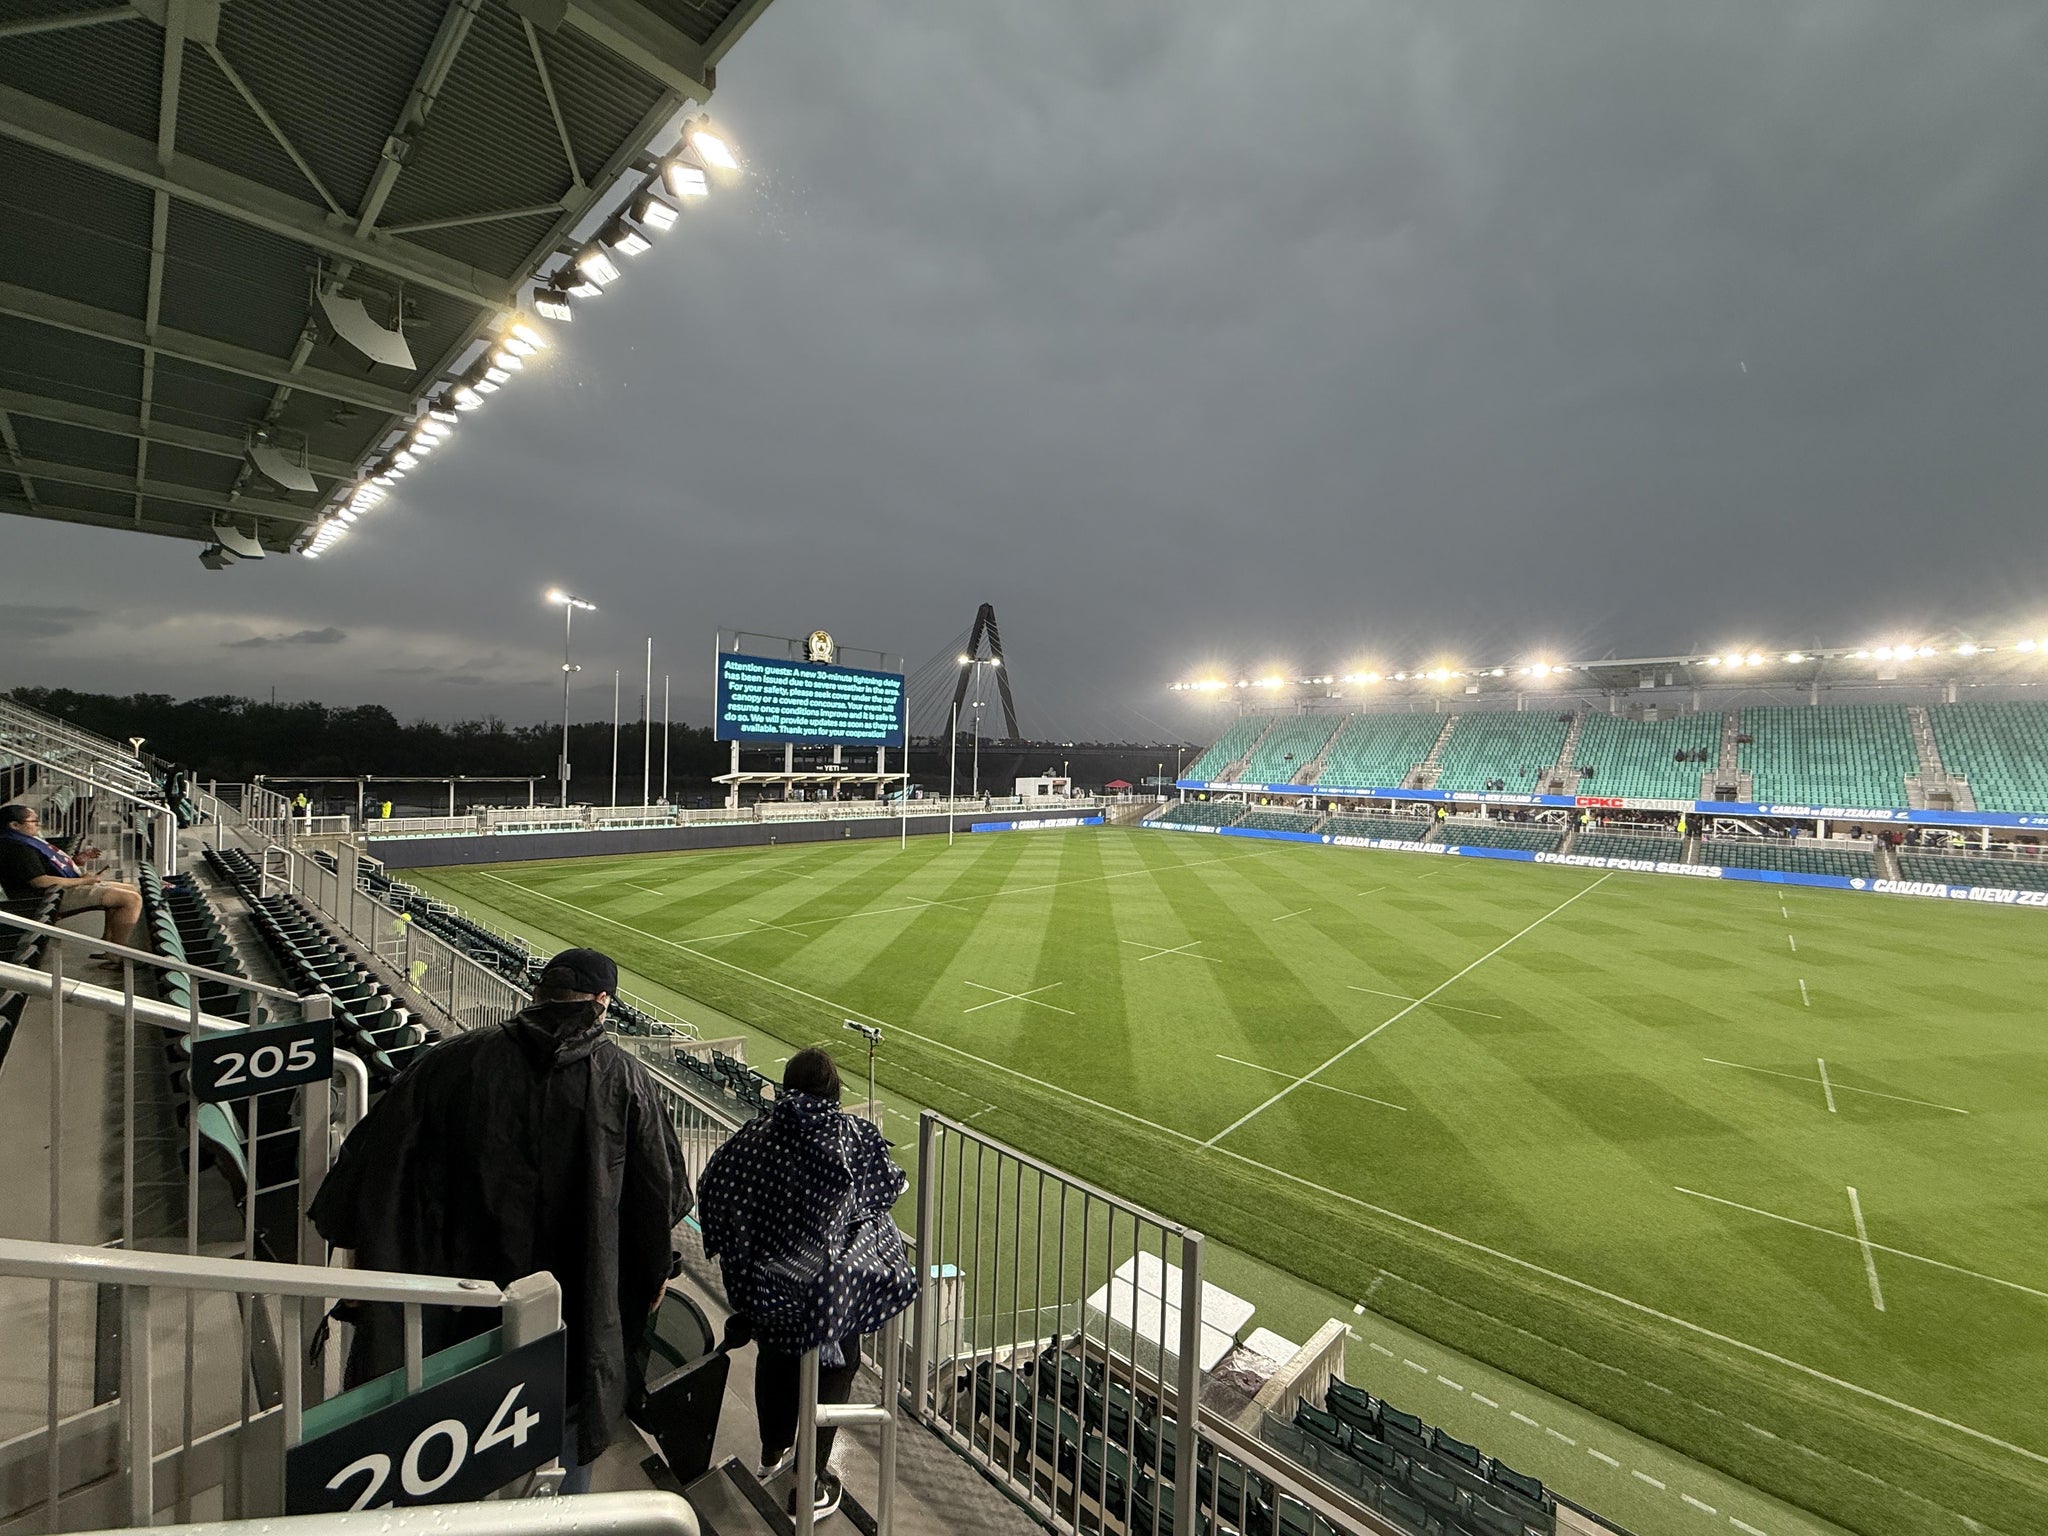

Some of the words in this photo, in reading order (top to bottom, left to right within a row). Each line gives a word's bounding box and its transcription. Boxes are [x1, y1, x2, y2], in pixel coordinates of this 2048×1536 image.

[724, 661, 763, 672] Attention
[724, 671, 740, 680] has
[741, 672, 762, 682] been
[763, 675, 788, 685] issued
[789, 678, 803, 686] due
[837, 684, 864, 692] weather
[729, 681, 743, 690] For
[790, 688, 813, 697] please
[731, 694, 762, 703] canopy
[779, 698, 809, 706] covered
[848, 702, 863, 710] Your
[728, 704, 759, 712] resume
[781, 707, 819, 716] conditions
[820, 709, 848, 718] improve
[724, 712, 736, 720] do
[750, 714, 764, 722] We
[765, 715, 779, 723] will
[780, 717, 808, 725] provide
[810, 719, 838, 727] updates
[873, 722, 887, 730] they
[741, 724, 778, 733] available.
[779, 725, 802, 734] Thank
[1500, 794, 1531, 802] ZEALAND
[1576, 797, 1624, 808] CPKC
[1626, 800, 1695, 812] STADIUM
[1770, 805, 1810, 815] CANADA
[1820, 807, 1845, 817] NEW
[1844, 809, 1892, 819] ZEALAND
[1334, 836, 1369, 848] CANADA
[1378, 839, 1402, 850] NEW
[1400, 841, 1445, 854] ZEALAND
[1546, 854, 1606, 867] PACIFIC
[1607, 858, 1655, 872] FOUR
[1655, 862, 1722, 877] SERIES
[1873, 879, 1947, 897] CANADA
[1950, 887, 1968, 899] vs
[1968, 887, 2018, 904] NEW
[212, 1037, 318, 1089] 205
[686, 1392, 692, 1402] 1
[325, 1382, 540, 1512] 204
